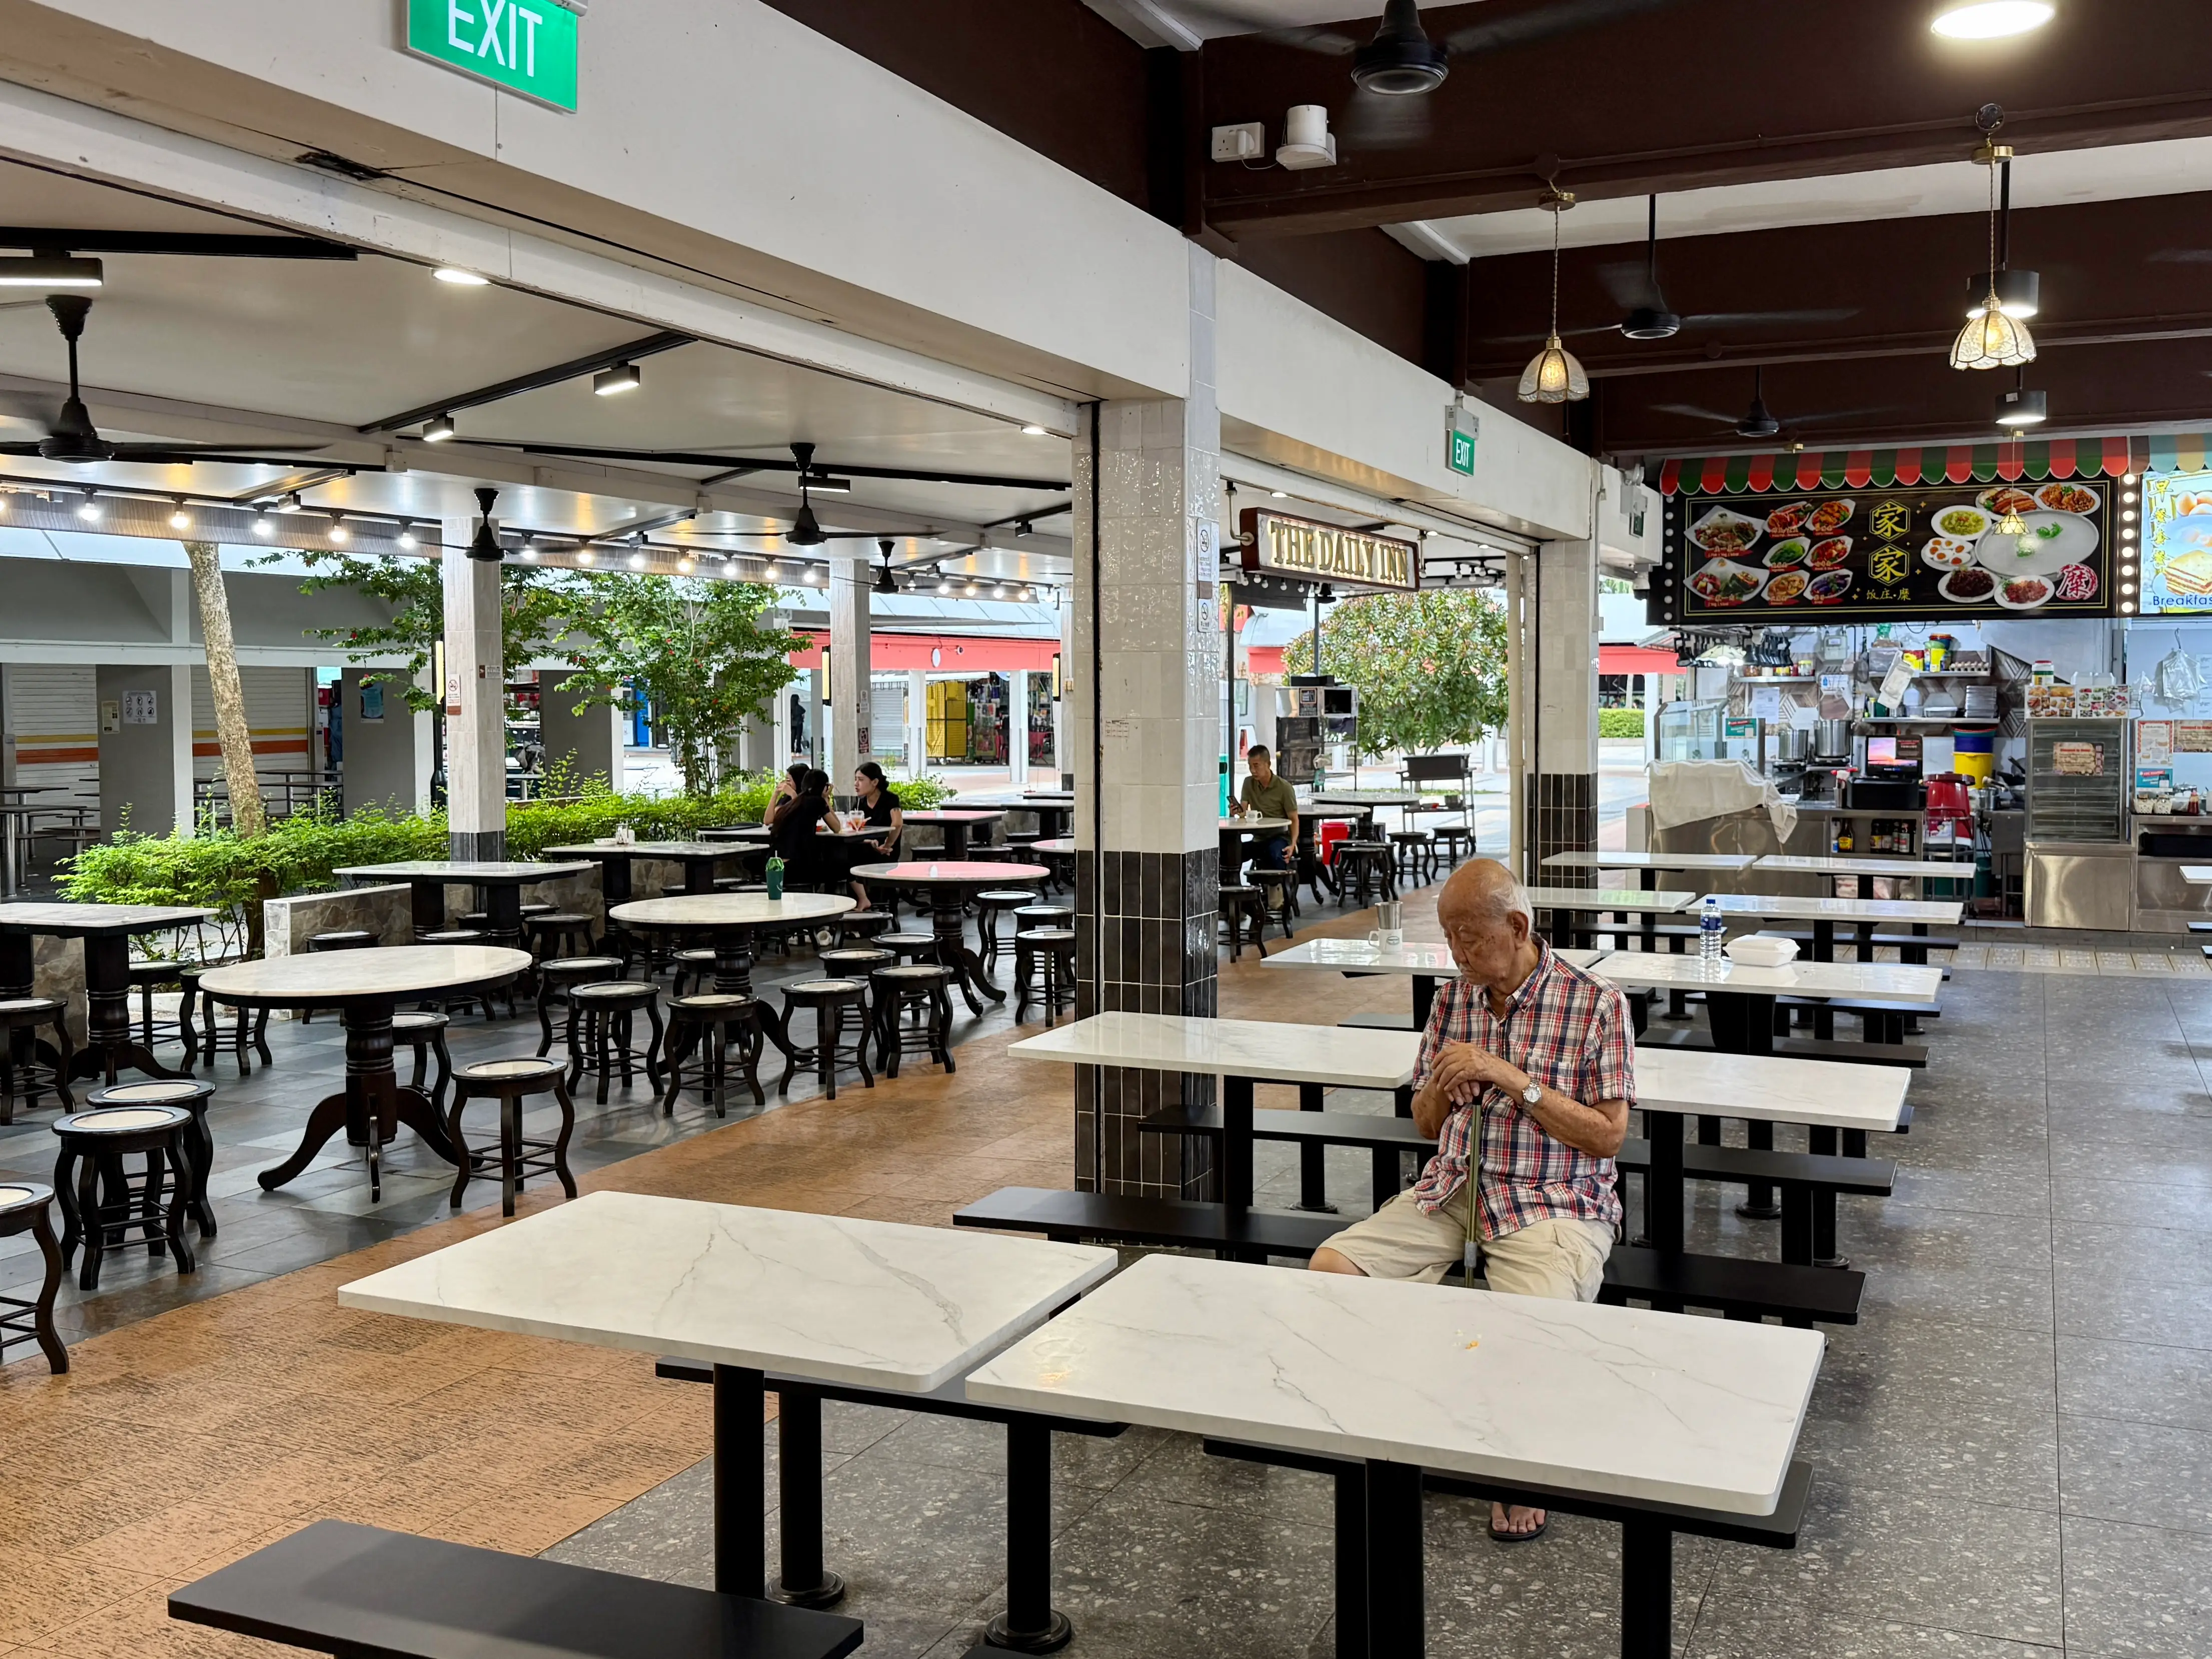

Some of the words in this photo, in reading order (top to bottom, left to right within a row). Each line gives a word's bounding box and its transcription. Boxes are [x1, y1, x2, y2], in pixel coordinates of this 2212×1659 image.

[449, 0, 543, 77] EXIT
[1456, 439, 1470, 467] EXIT
[1271, 521, 1315, 568] THE
[1319, 531, 1375, 577] DAILY
[1378, 544, 1408, 583] INN
